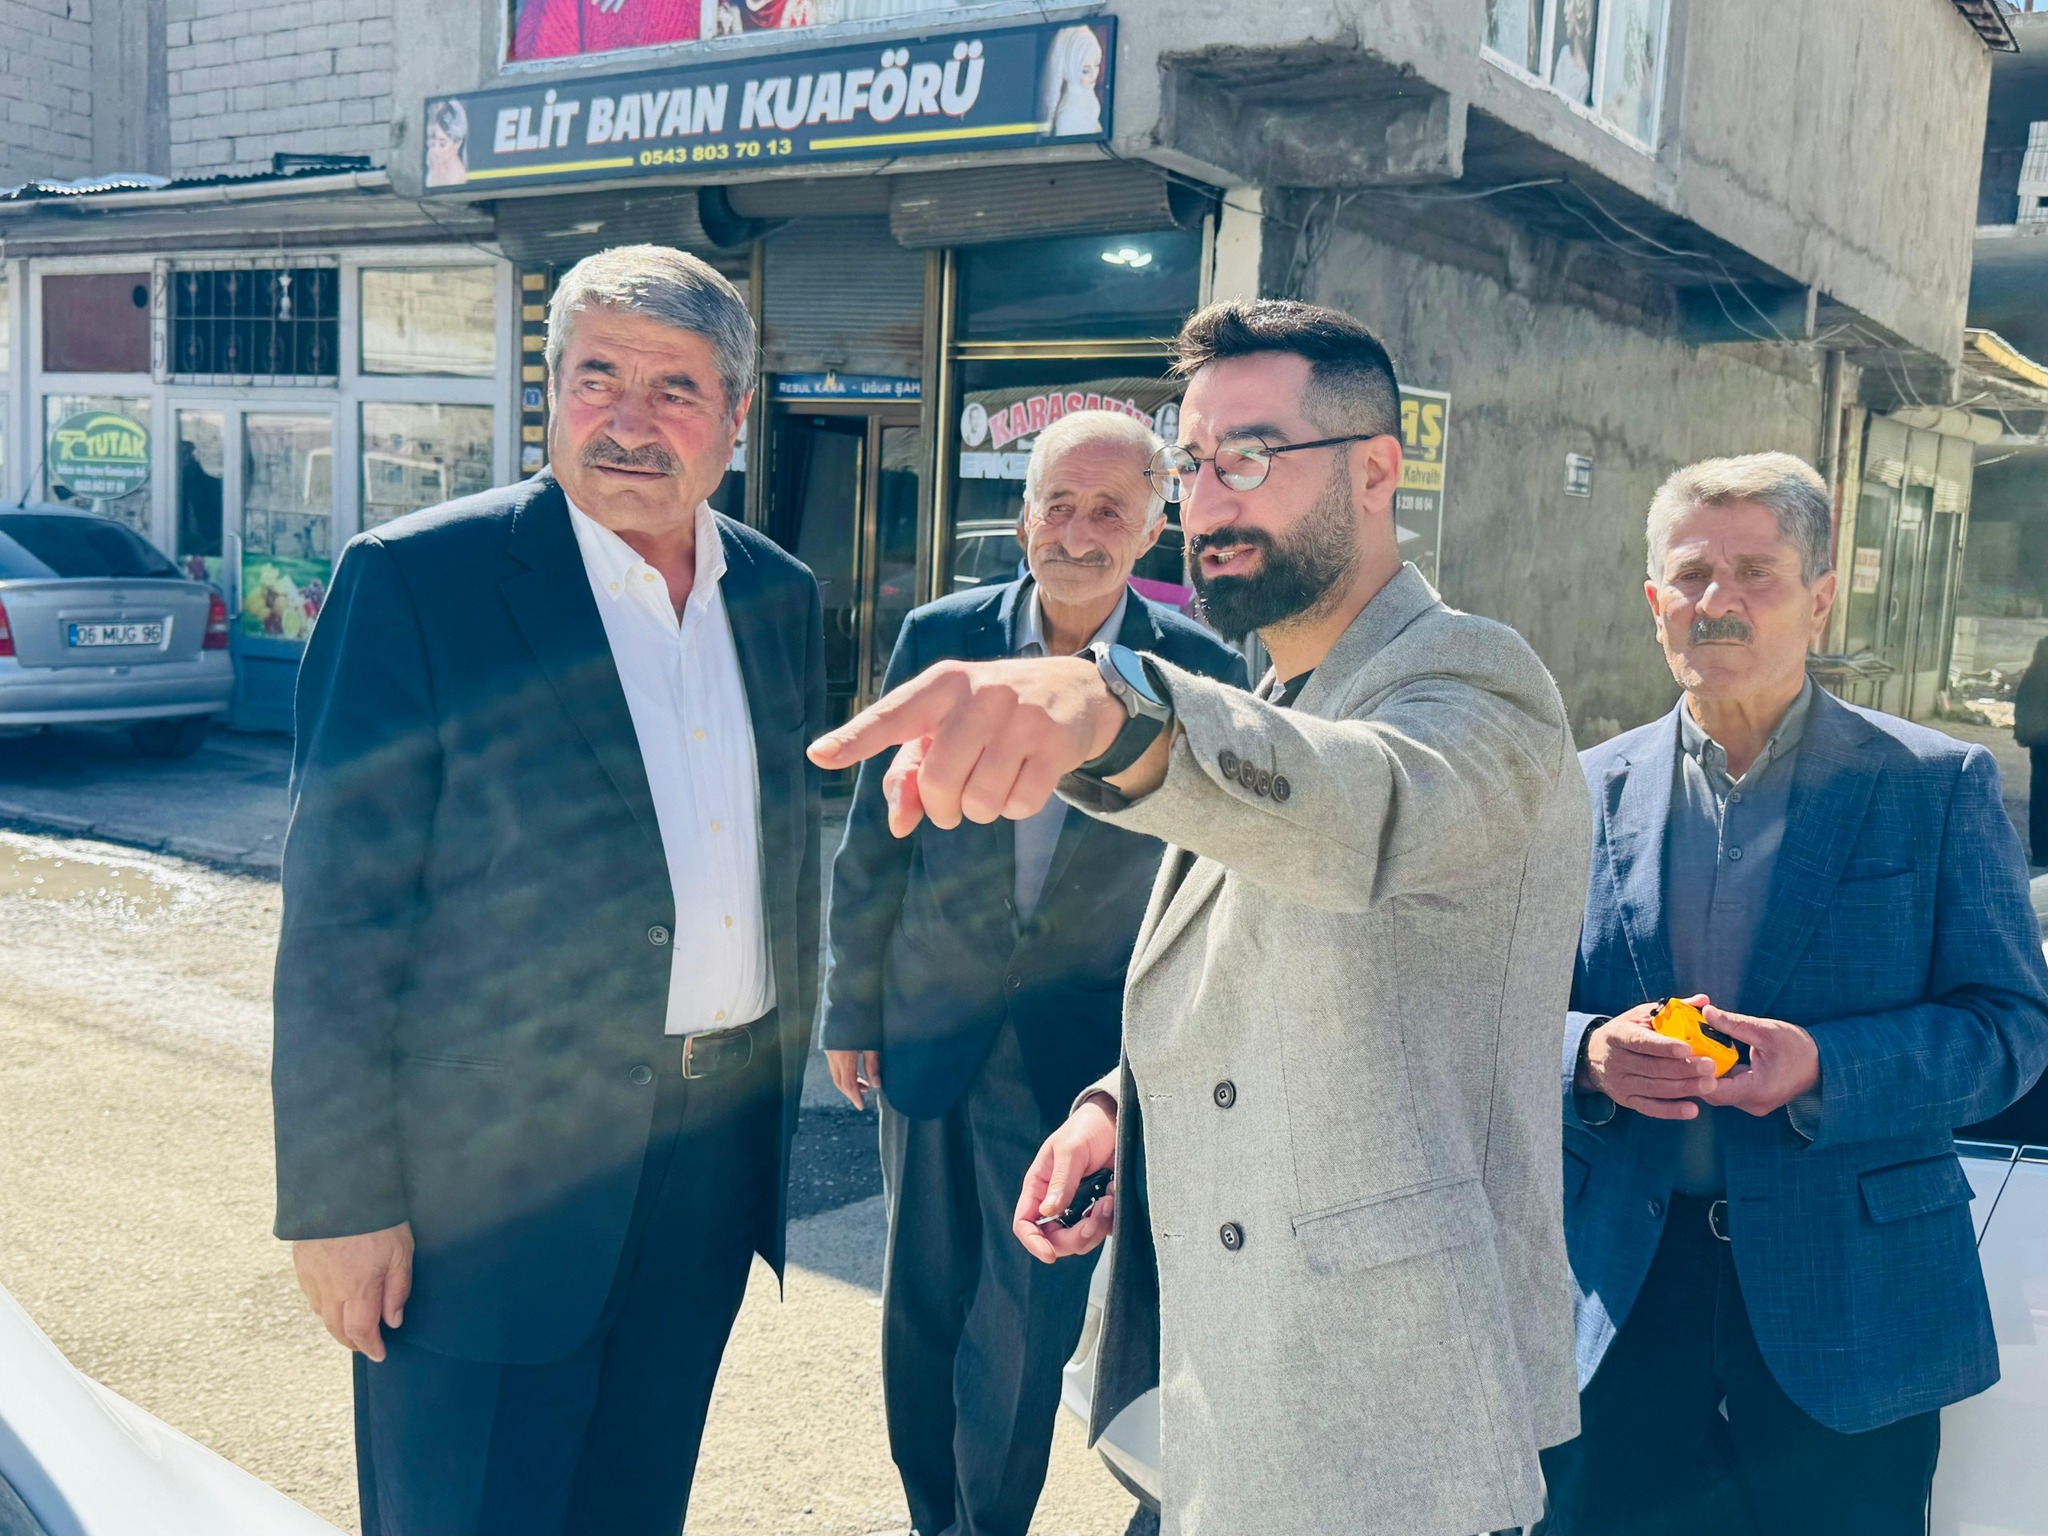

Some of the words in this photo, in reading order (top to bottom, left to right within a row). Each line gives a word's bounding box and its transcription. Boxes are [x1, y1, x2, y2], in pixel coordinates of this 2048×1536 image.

[493, 88, 581, 154] ELİT
[586, 83, 729, 145] BAYAN
[739, 38, 985, 131] KUAFÖRÜ
[639, 147, 687, 166] 0543
[692, 144, 729, 162] 803
[735, 140, 761, 158] 70
[766, 138, 792, 156] 13
